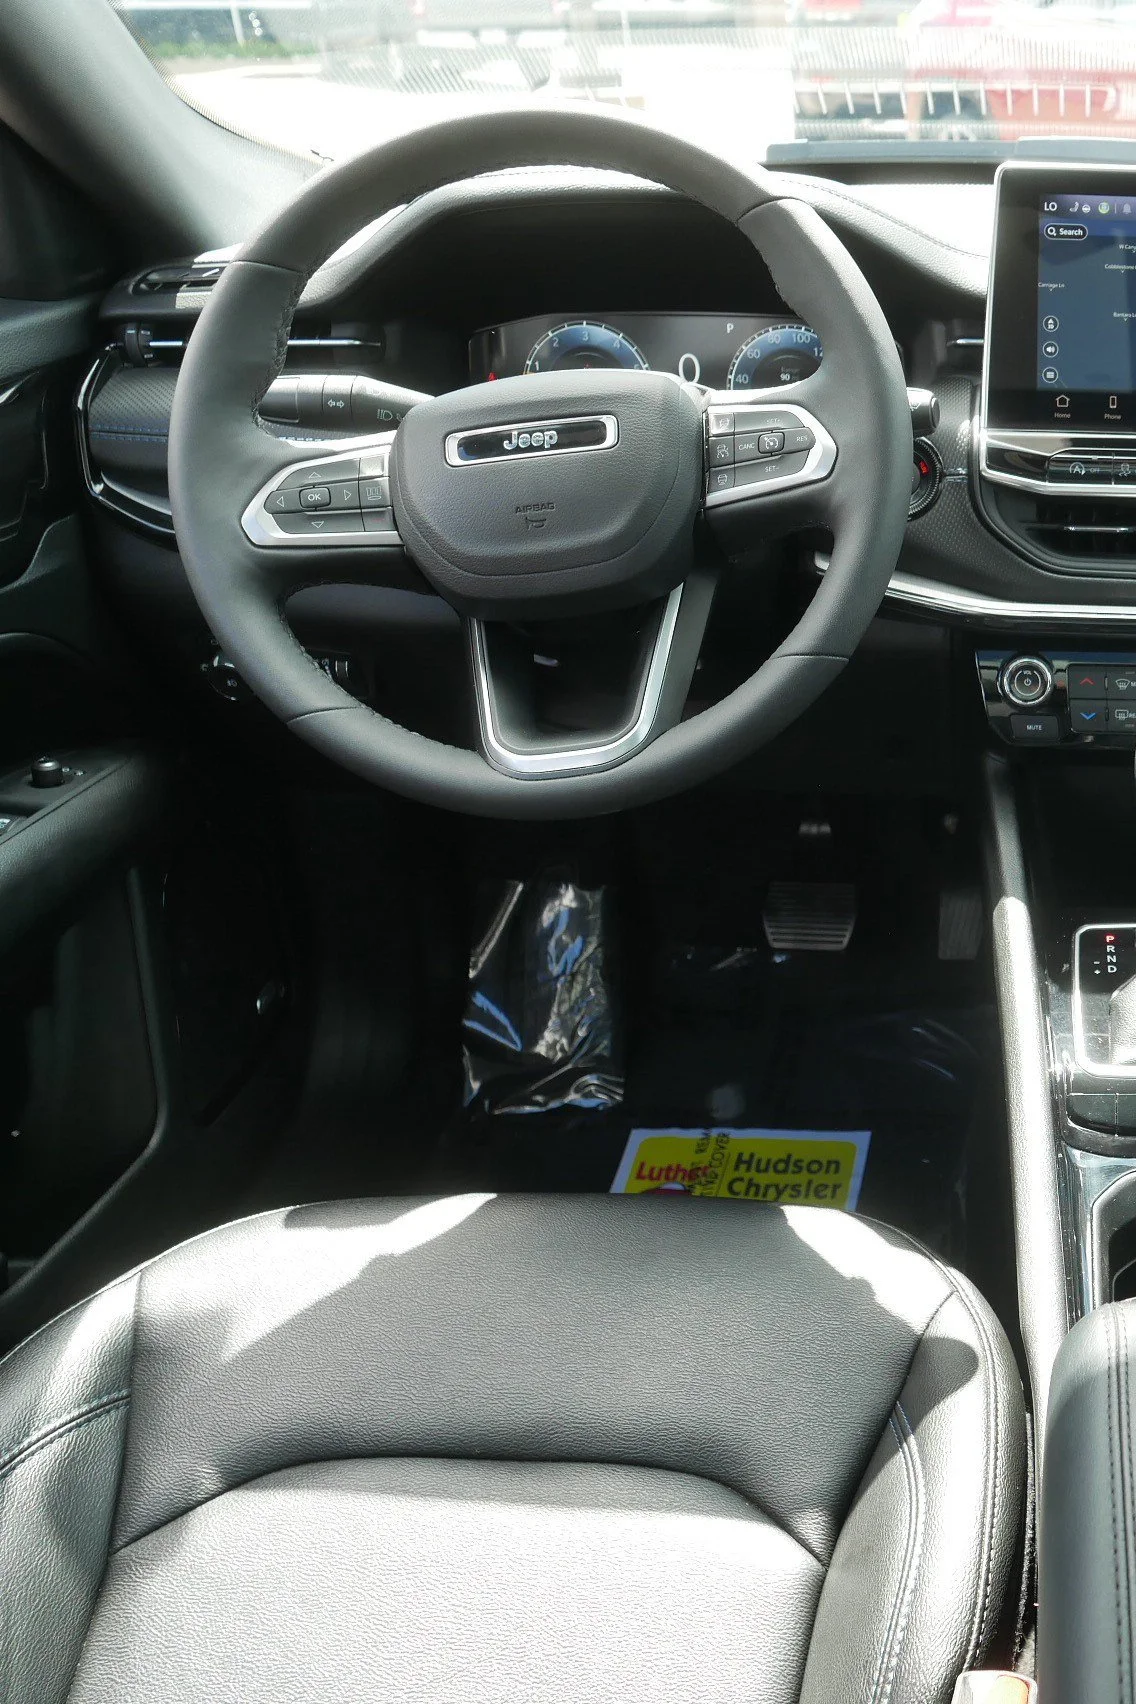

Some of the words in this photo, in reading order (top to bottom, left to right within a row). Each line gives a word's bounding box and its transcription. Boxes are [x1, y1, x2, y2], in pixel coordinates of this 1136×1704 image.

[1044, 202, 1058, 212] LO
[1059, 228, 1084, 237] Search
[726, 322, 734, 334] P
[582, 331, 589, 341] 3
[768, 333, 781, 344] 80
[792, 333, 810, 344] 100
[552, 338, 559, 348] 2
[613, 340, 620, 348] 4
[746, 348, 760, 359] 60
[678, 352, 700, 384] 0
[735, 374, 749, 384] 40
[780, 373, 790, 382] 90
[503, 430, 558, 450] Jeep
[738, 442, 756, 451] CANC
[307, 492, 322, 501] OK
[515, 502, 556, 514] AIRBAG
[1107, 965, 1118, 973] D
[733, 1151, 842, 1175] Hudson
[727, 1176, 842, 1202] Chrysler
